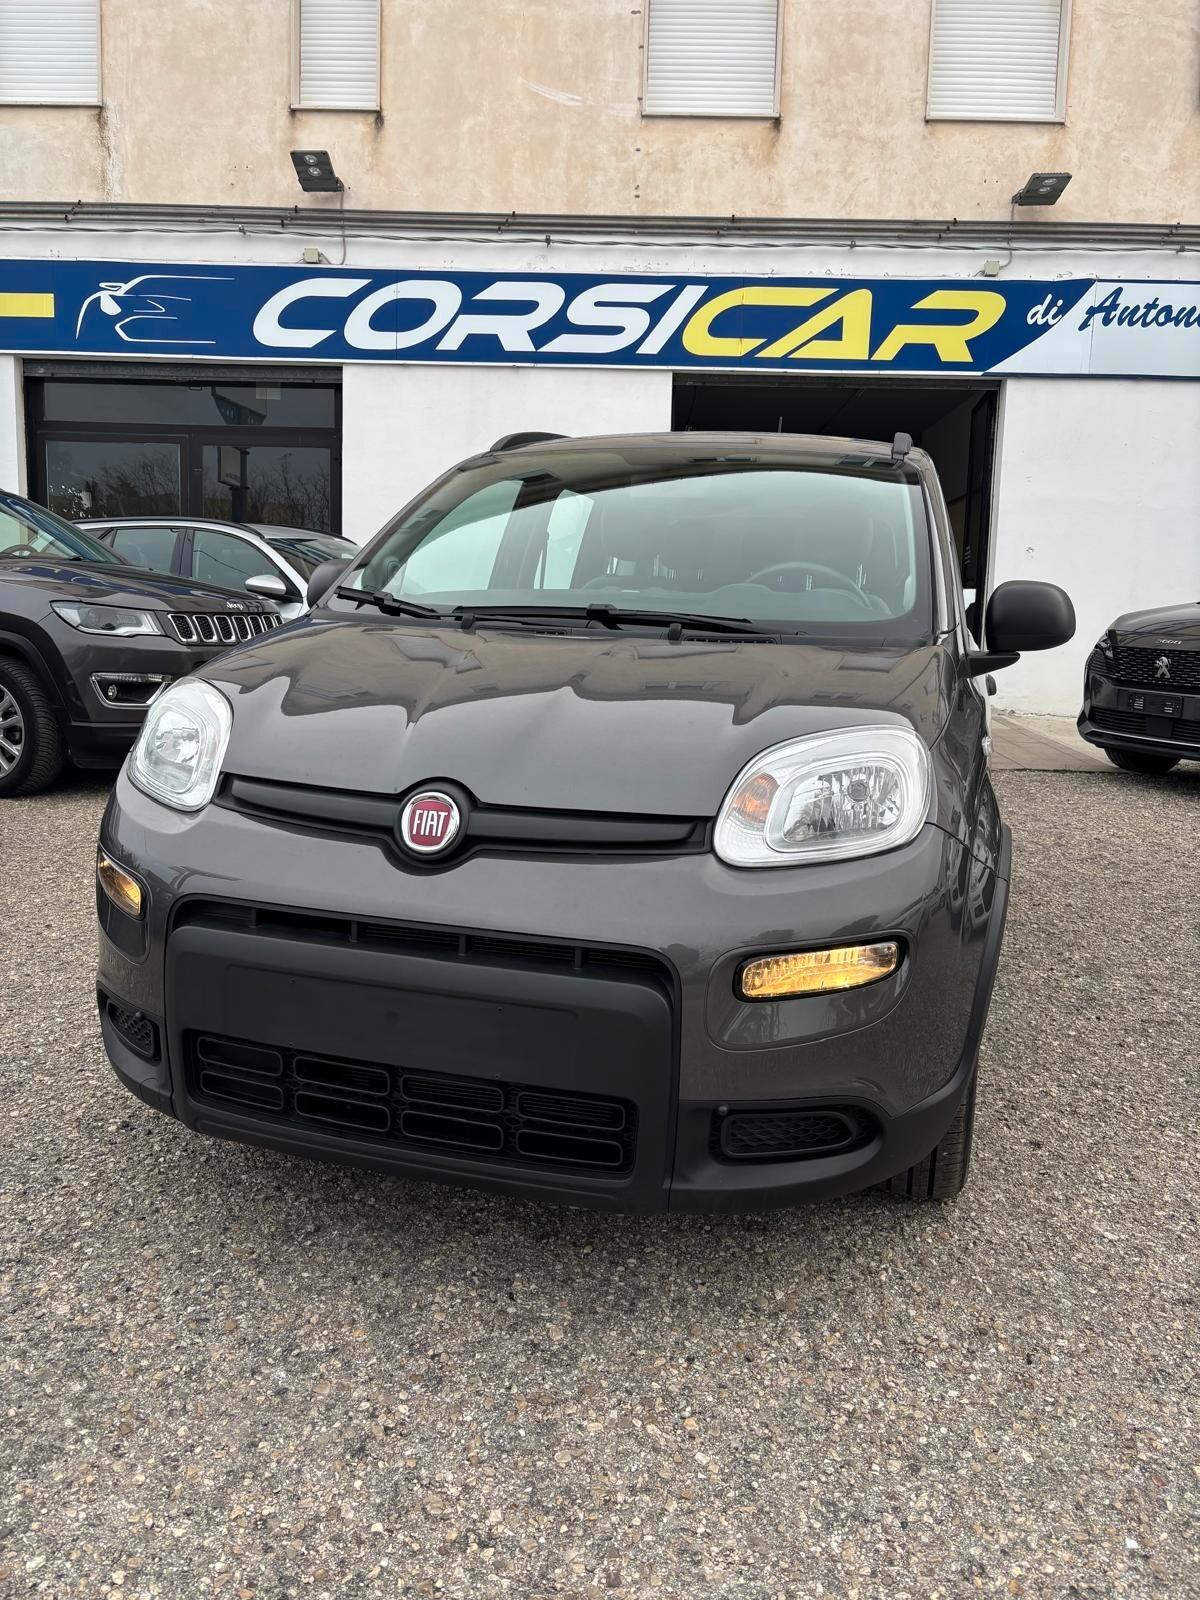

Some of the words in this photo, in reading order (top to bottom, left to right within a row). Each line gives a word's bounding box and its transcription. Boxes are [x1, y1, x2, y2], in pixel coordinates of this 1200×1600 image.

[252, 277, 1007, 363] CORSICAR
[1027, 293, 1064, 326] di
[412, 809, 449, 837] FIAT
